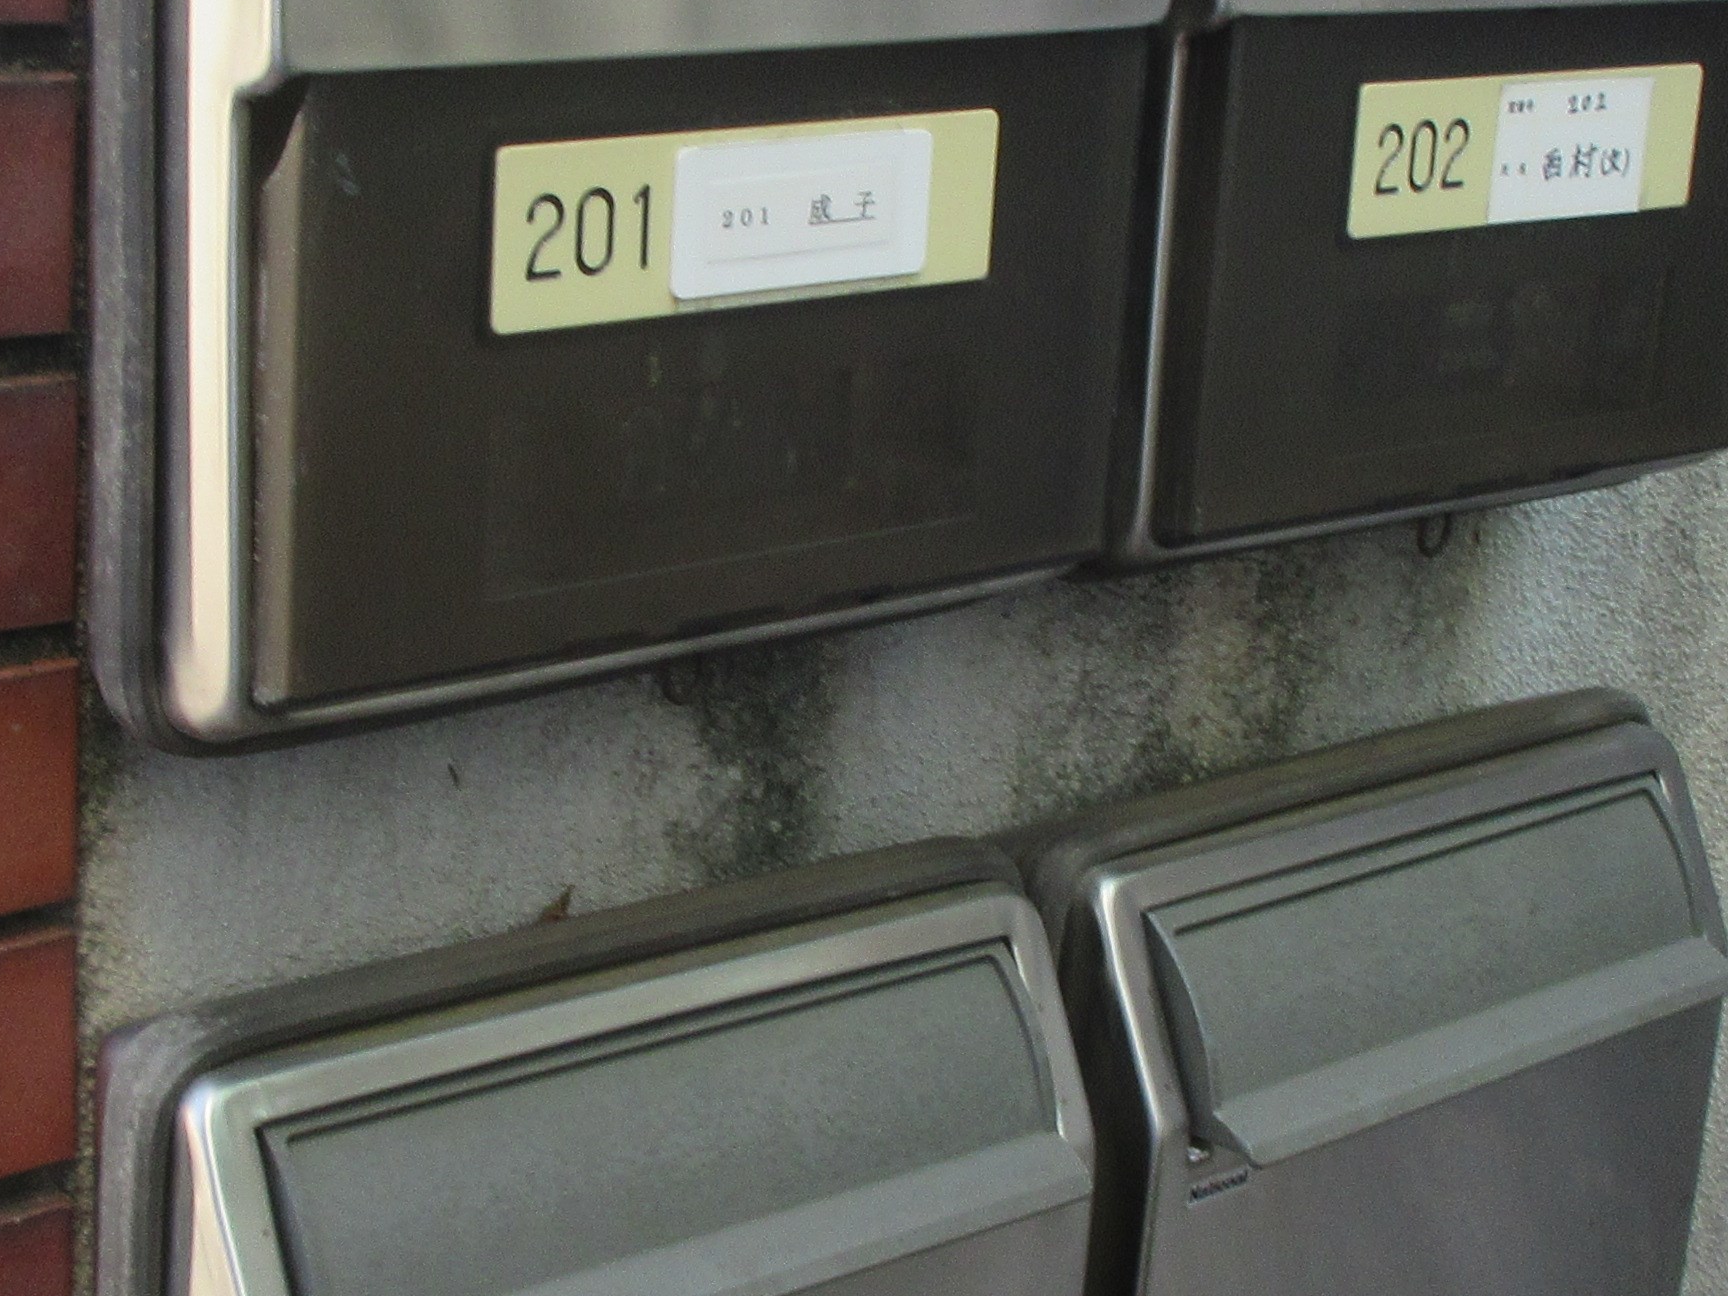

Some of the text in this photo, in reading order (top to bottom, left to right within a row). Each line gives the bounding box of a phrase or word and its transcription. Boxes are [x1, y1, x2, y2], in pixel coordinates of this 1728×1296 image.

[1374, 117, 1470, 196] 202
[526, 183, 654, 281] 201
[721, 206, 770, 229] 201
